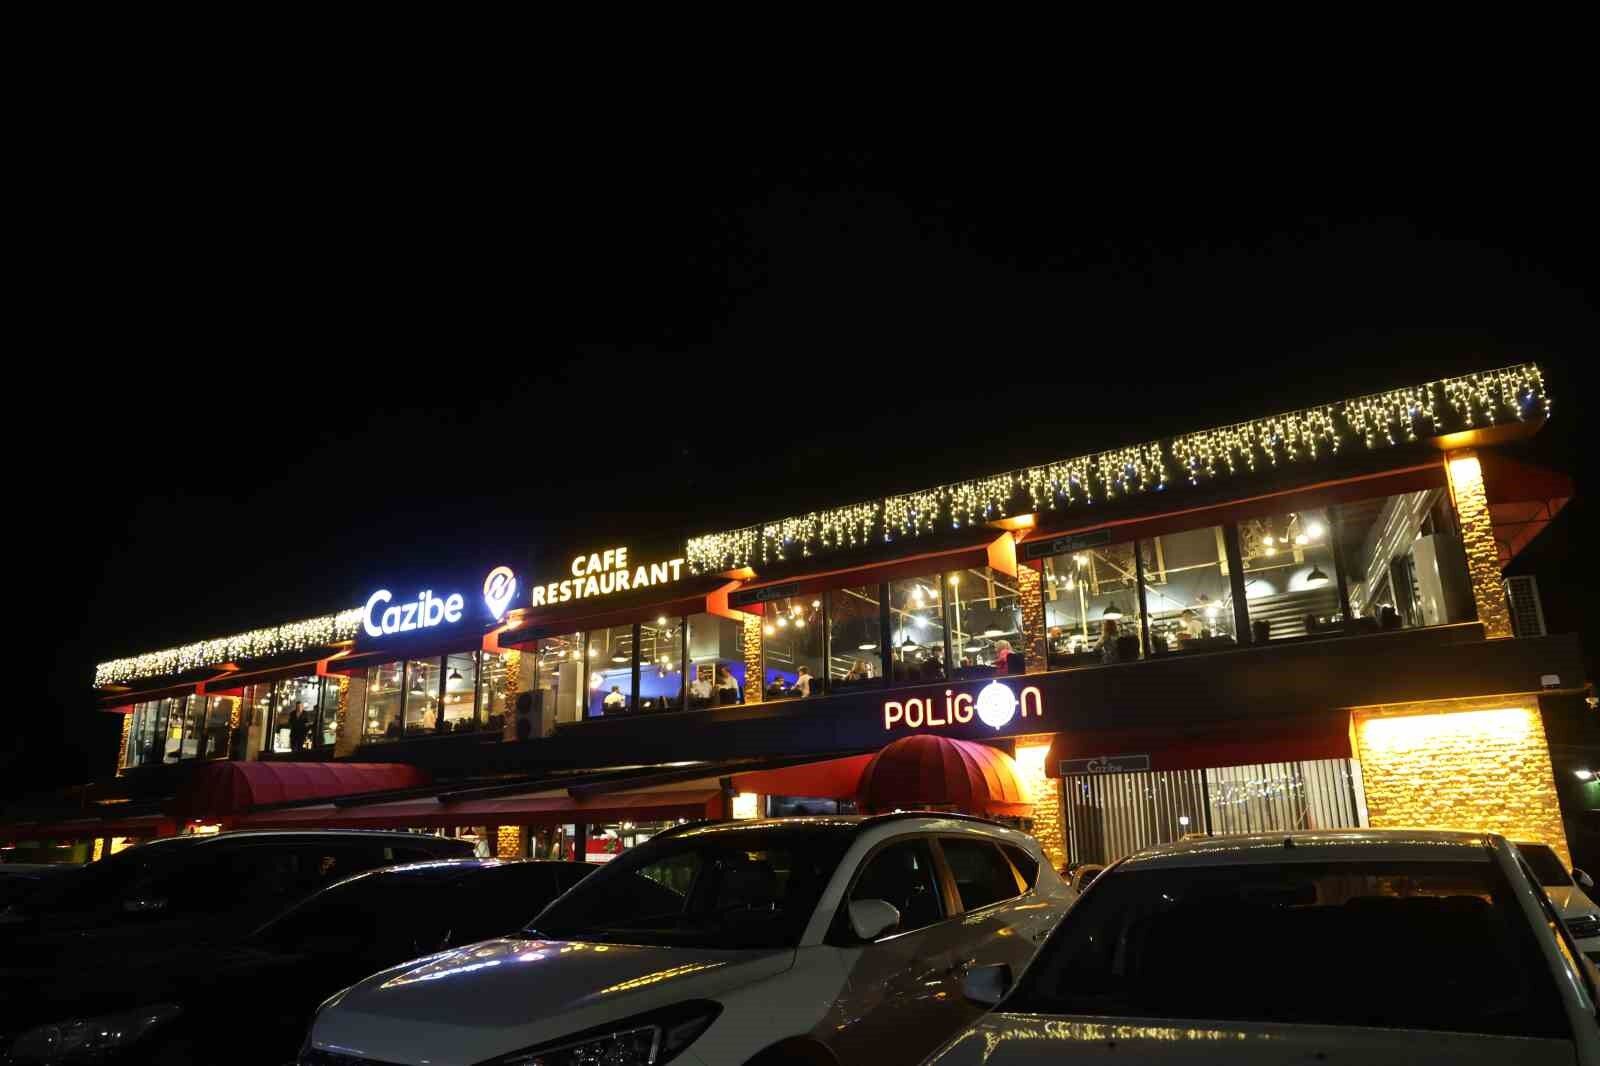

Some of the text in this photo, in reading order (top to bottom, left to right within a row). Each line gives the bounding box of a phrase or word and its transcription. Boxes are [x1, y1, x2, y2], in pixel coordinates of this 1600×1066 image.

[532, 558, 685, 607] RESTAURANT
[571, 546, 628, 578] CAFE
[363, 589, 464, 637] Cazibe
